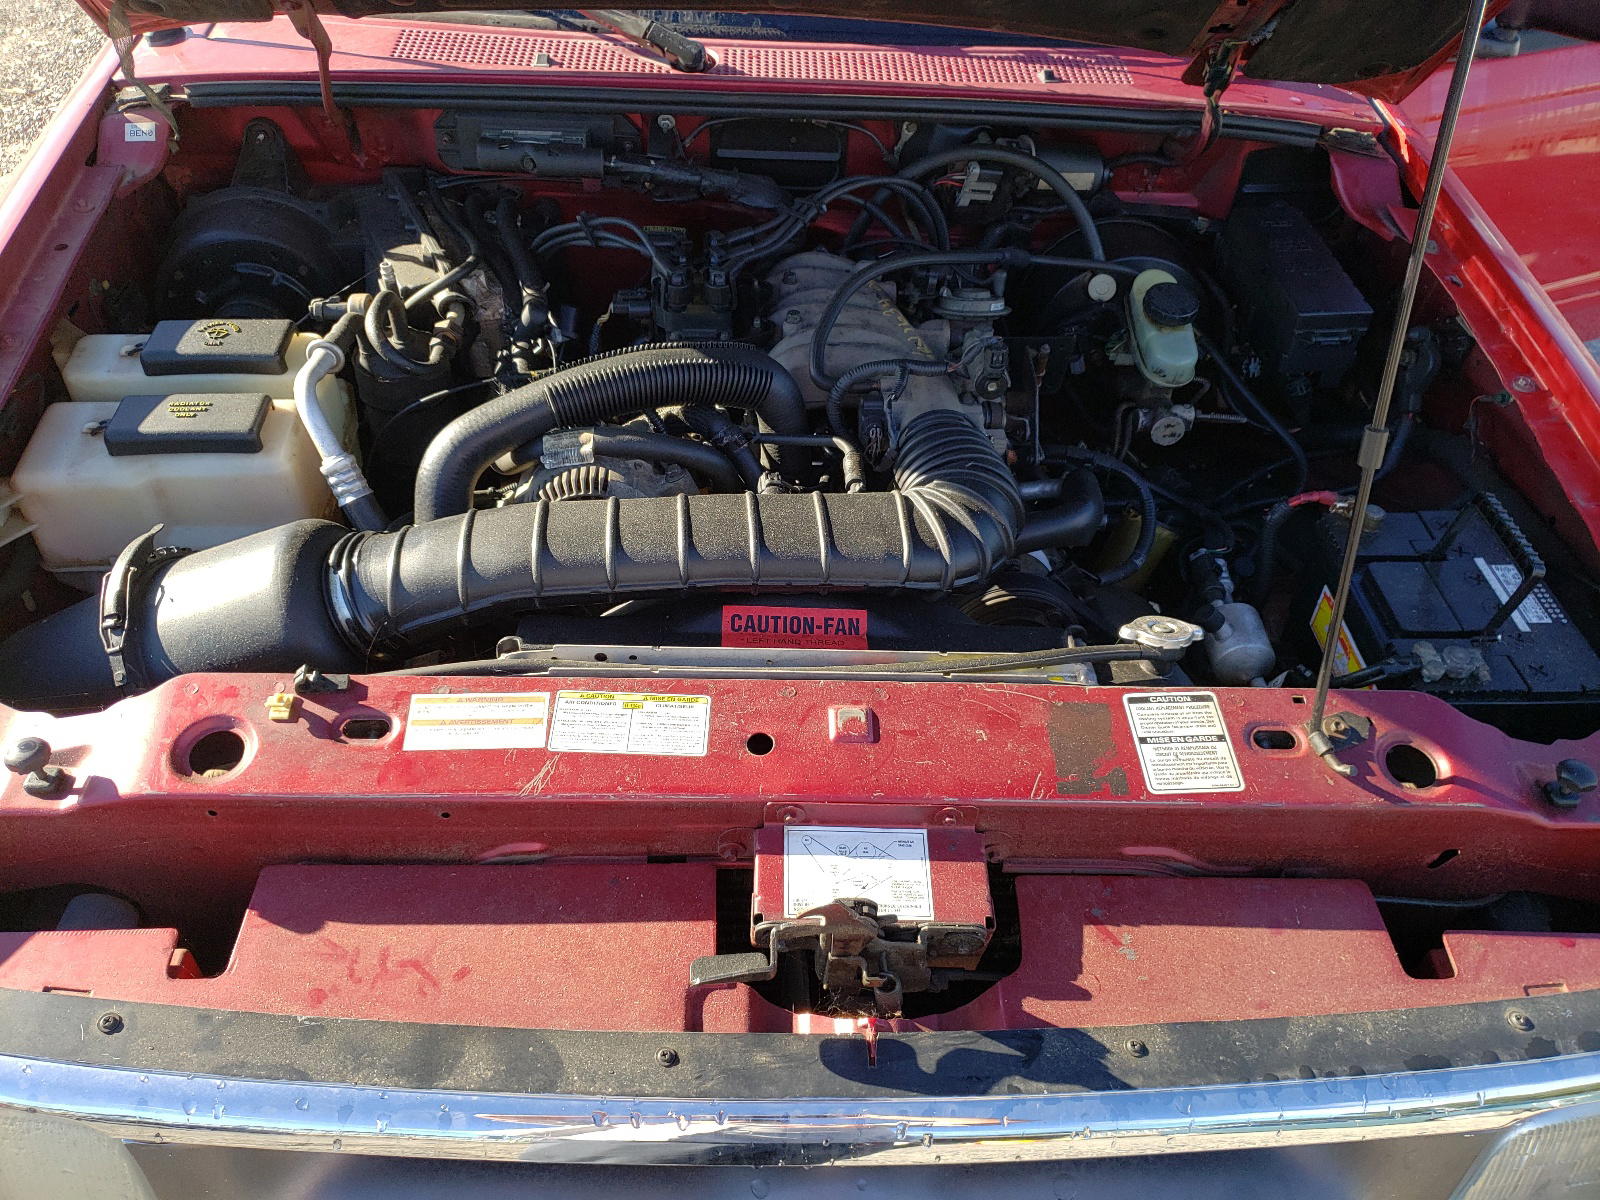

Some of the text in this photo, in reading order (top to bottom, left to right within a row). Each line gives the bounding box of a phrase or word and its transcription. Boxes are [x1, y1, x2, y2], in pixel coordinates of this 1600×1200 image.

[730, 613, 861, 636] CAUTION-FAN
[1149, 695, 1192, 703] CAUTION
[1146, 736, 1171, 744] MISE
[1185, 735, 1219, 743] GARDE
